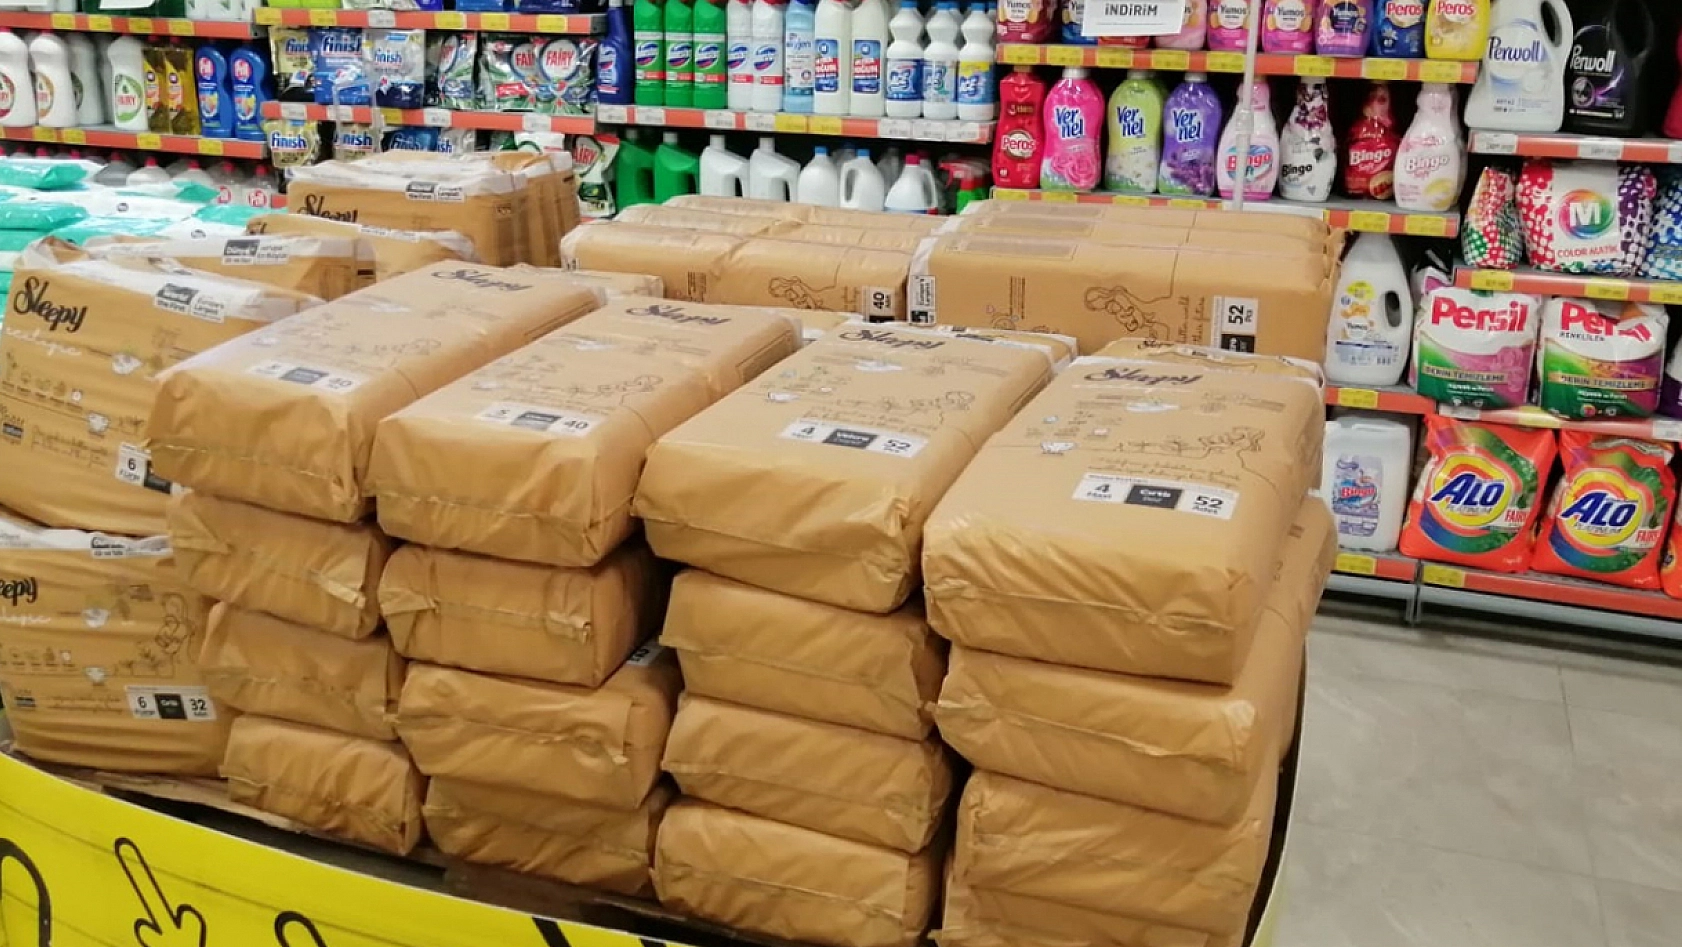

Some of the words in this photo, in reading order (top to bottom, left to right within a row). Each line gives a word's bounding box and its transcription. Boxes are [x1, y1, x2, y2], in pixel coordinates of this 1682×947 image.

[1387, 2, 1422, 16] Peros
[1437, 0, 1475, 15] Peros
[546, 48, 573, 66] FAIRY
[1489, 36, 1542, 62] Perwoll
[1570, 44, 1616, 73] Perwoll
[1056, 107, 1079, 124] Ver
[1117, 106, 1139, 124] Ver
[1173, 109, 1197, 128] Ver
[1062, 120, 1084, 138] nel
[1122, 119, 1144, 138] nel
[1179, 122, 1201, 141] nel
[271, 130, 307, 149] finish
[1349, 149, 1392, 166] Bingo
[1406, 156, 1450, 173] Bingo
[1282, 163, 1313, 177] Bingo
[1569, 202, 1601, 227] M
[13, 275, 89, 333] Sleepy
[873, 292, 885, 309] 40
[1228, 304, 1245, 324] 52
[1432, 296, 1530, 333] Persil
[127, 457, 137, 471] 6
[1094, 483, 1111, 493] 4
[1431, 472, 1506, 508] ALO
[1194, 496, 1224, 509] 52
[1560, 491, 1637, 527] ALO
[138, 696, 148, 709] 6
[190, 697, 207, 711] 32
